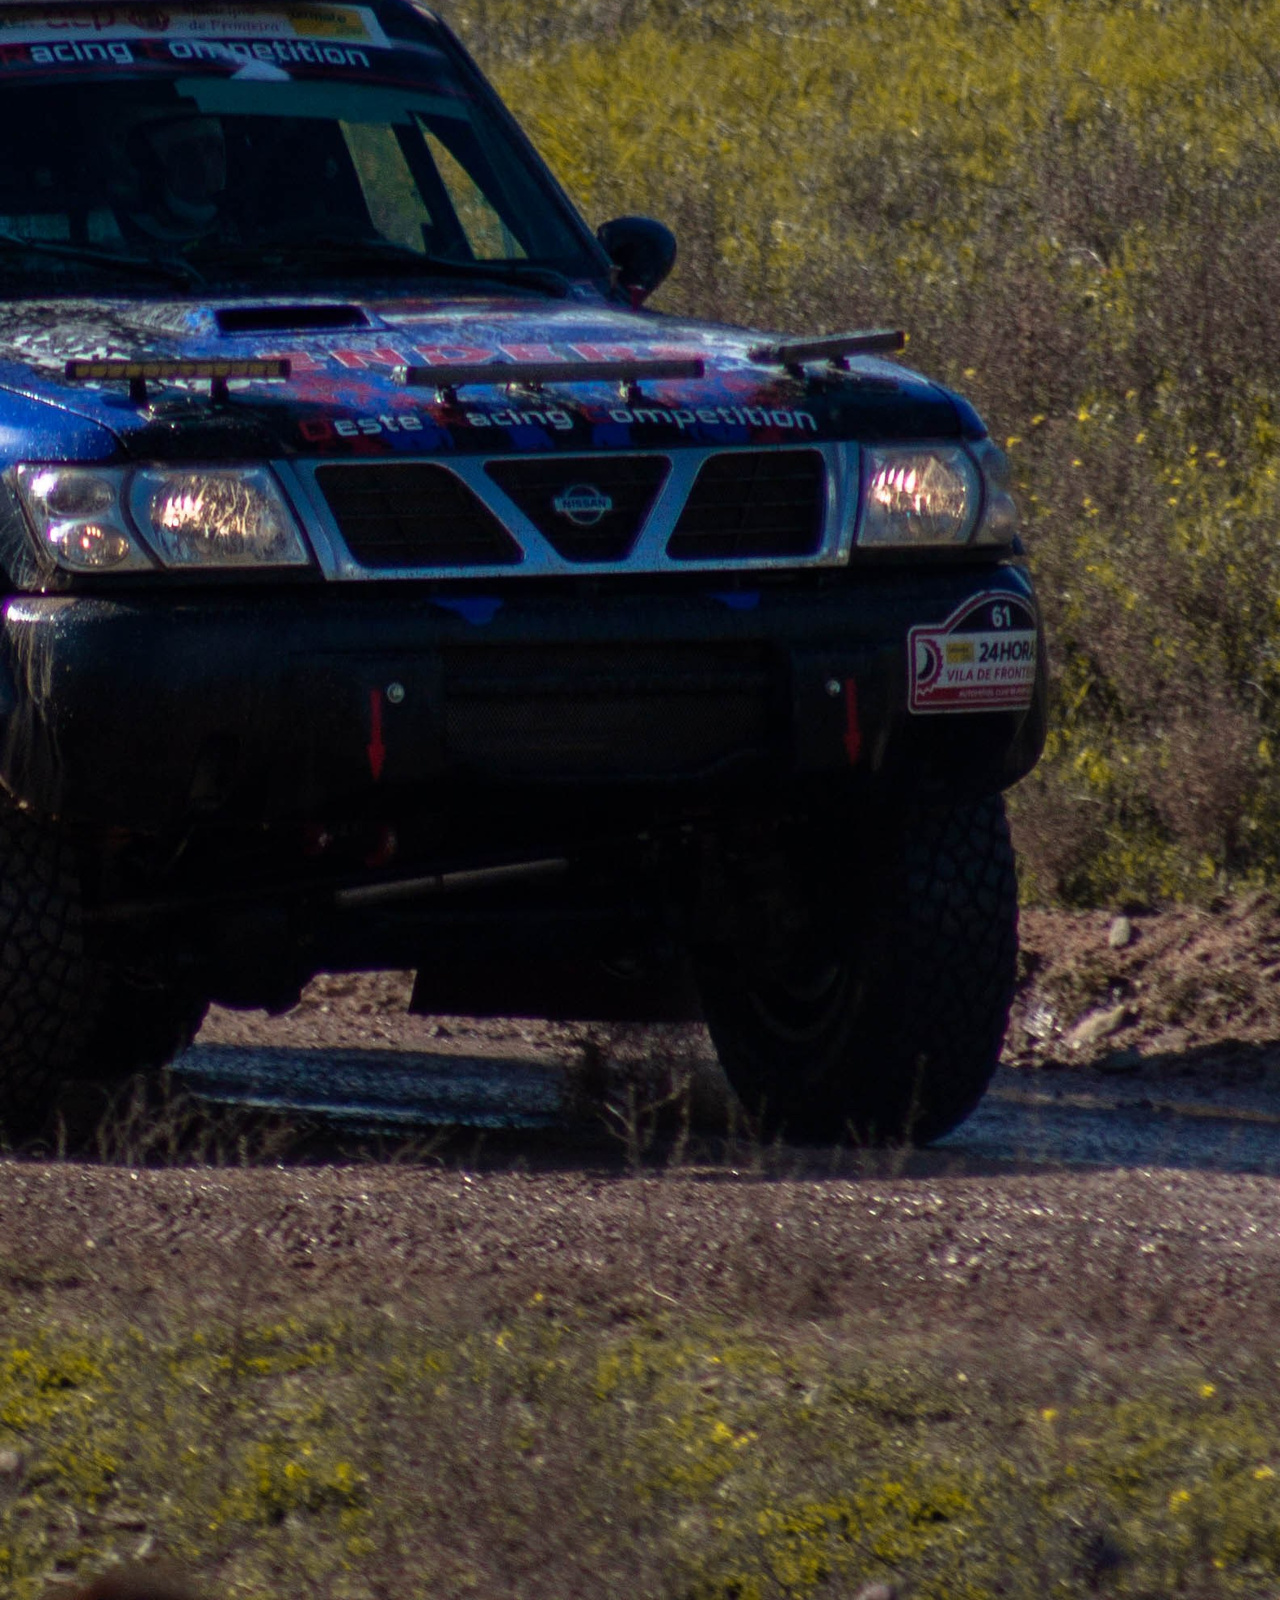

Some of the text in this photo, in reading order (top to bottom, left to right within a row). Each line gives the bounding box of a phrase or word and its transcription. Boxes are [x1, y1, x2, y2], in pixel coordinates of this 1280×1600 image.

[991, 605, 1012, 628] 61
[978, 640, 1037, 663] 24HORA
[947, 664, 1035, 682] VILA DE FRONT
